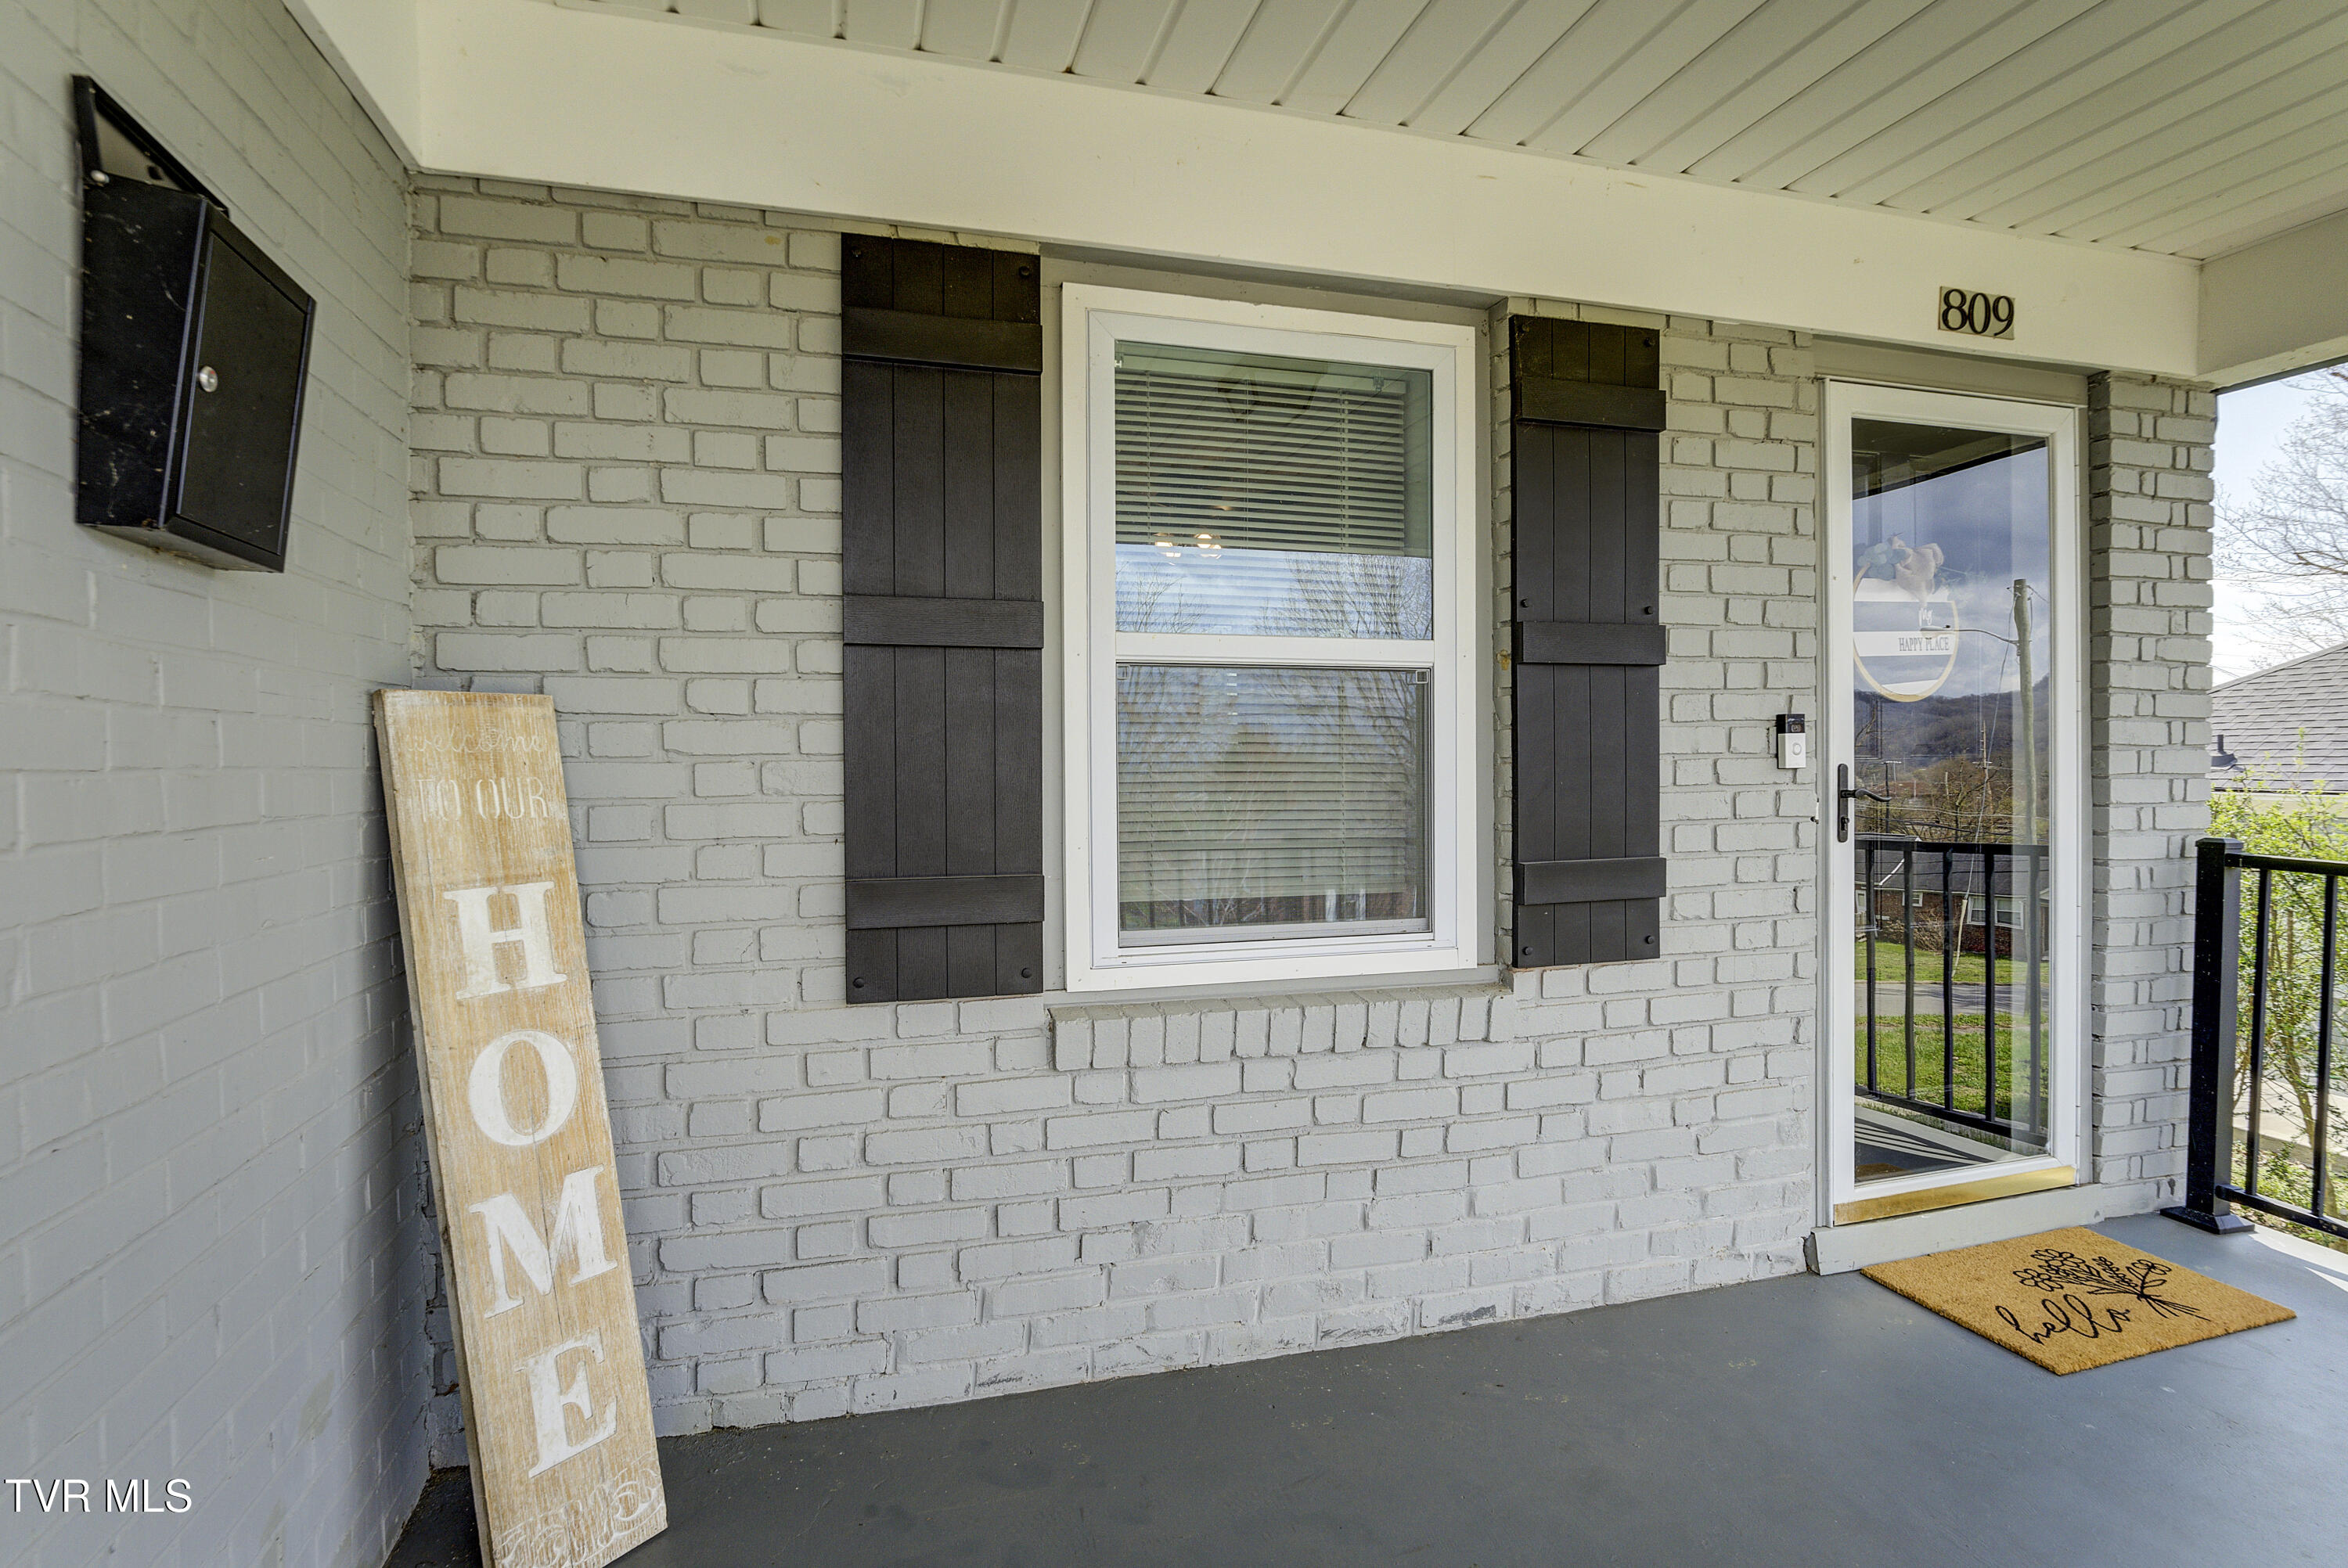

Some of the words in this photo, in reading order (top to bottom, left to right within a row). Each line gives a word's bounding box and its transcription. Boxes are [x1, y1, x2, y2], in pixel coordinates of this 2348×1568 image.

[1942, 289, 2015, 336] 809
[1898, 637, 1923, 652] HAPPY
[1925, 636, 1950, 651] PLACE
[407, 725, 547, 753] welcome
[415, 779, 462, 822] TO
[475, 776, 549, 820] OUR
[443, 880, 618, 1479] HOME
[1995, 1293, 2130, 1345] hello
